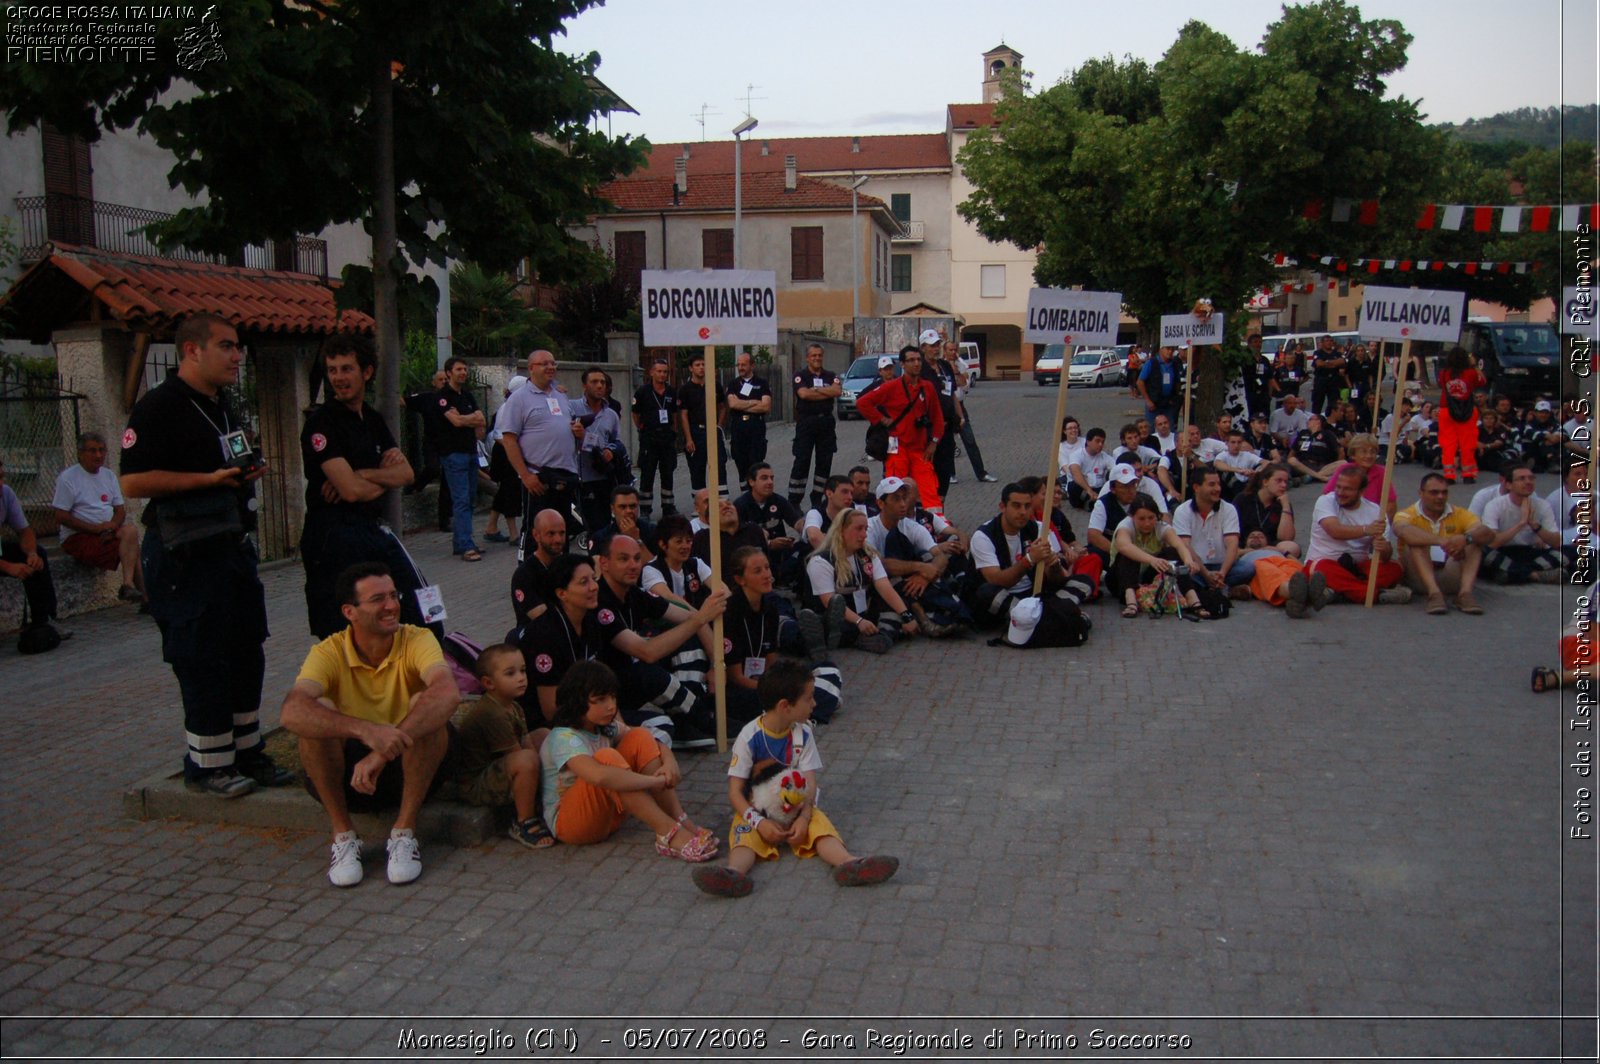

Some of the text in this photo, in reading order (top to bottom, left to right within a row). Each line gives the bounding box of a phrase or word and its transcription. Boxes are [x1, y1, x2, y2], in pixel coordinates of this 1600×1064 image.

[647, 287, 775, 319] BORGOMANERO
[1366, 300, 1451, 326] VILLANOVA
[1029, 307, 1109, 333] LOMBARDIA
[1164, 325, 1184, 339] BASSA
[1192, 323, 1216, 338] SCRIVIA
